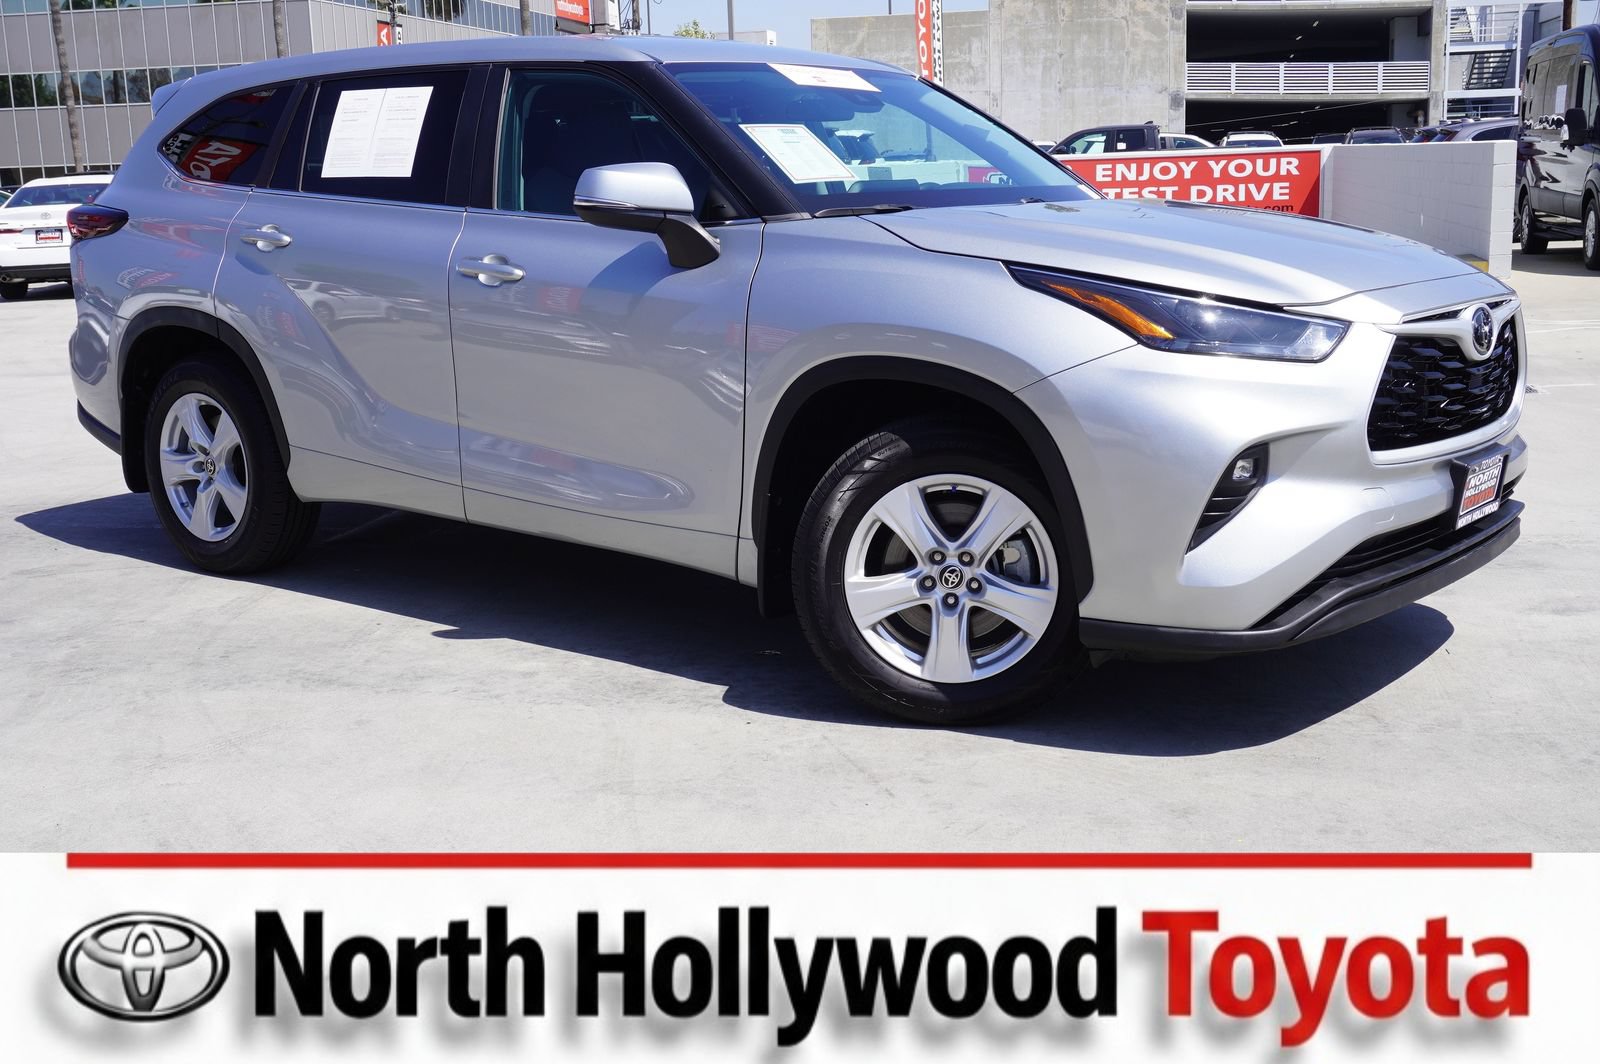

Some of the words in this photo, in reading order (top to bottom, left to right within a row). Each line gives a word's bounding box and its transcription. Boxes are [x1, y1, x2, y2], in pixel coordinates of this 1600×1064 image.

[1095, 160, 1199, 182] ENJOY
[1207, 157, 1300, 178] YOUR
[1102, 186, 1178, 200] TEST
[1190, 182, 1290, 203] DRIVE
[1469, 465, 1500, 488] NORTH
[1465, 478, 1496, 498] HOLLYWOOD
